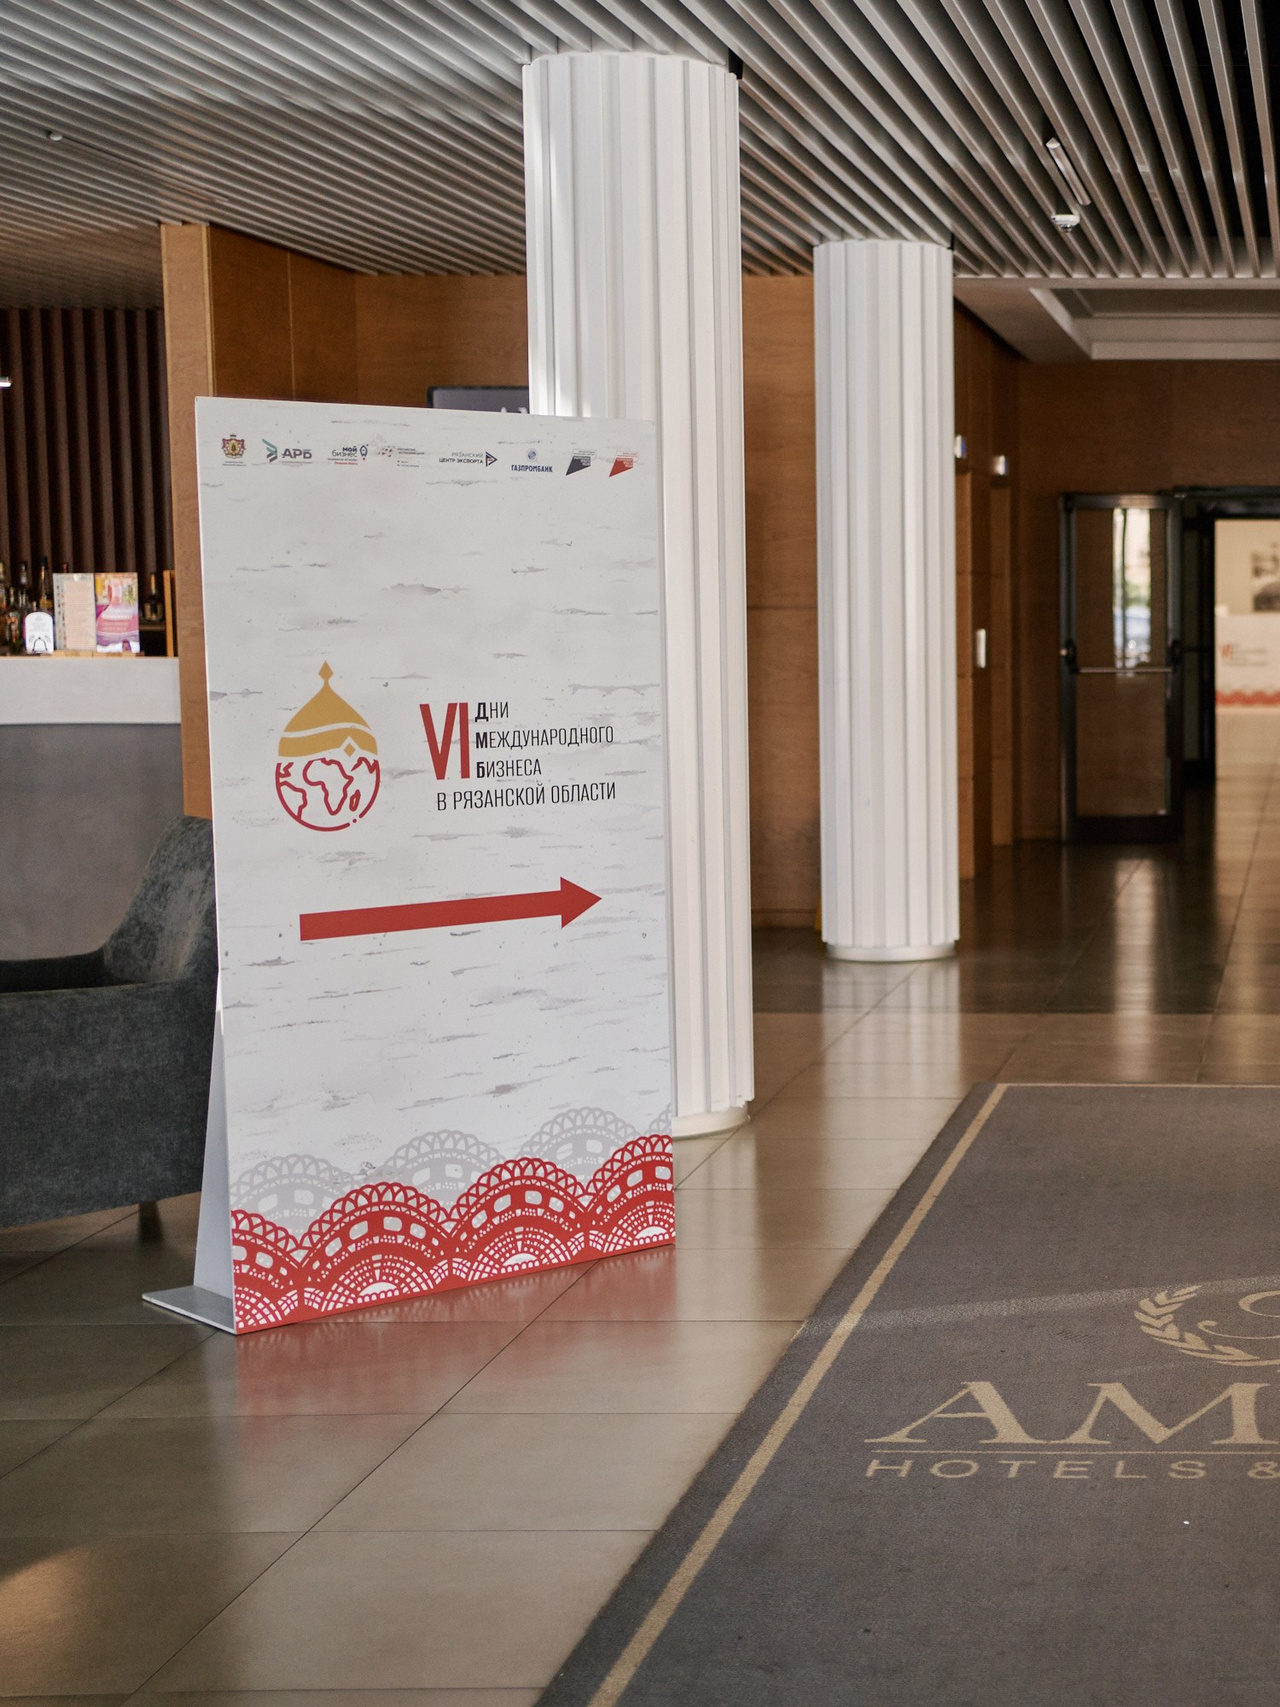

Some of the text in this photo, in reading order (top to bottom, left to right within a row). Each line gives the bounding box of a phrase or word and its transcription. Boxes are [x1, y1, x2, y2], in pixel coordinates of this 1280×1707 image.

[281, 448, 312, 459] АРБ
[511, 464, 553, 473] ГАЗПРОМБАНК
[474, 702, 509, 722] ДНИ
[419, 702, 470, 780] VI
[475, 725, 614, 750] МЕЖДУНАРОДНОГО
[476, 758, 542, 779] БИЗНЕСА
[437, 782, 616, 811] В РЯЗАНСКОЙ ОБЛАСТИ
[864, 1458, 1207, 1480] HOTELS
